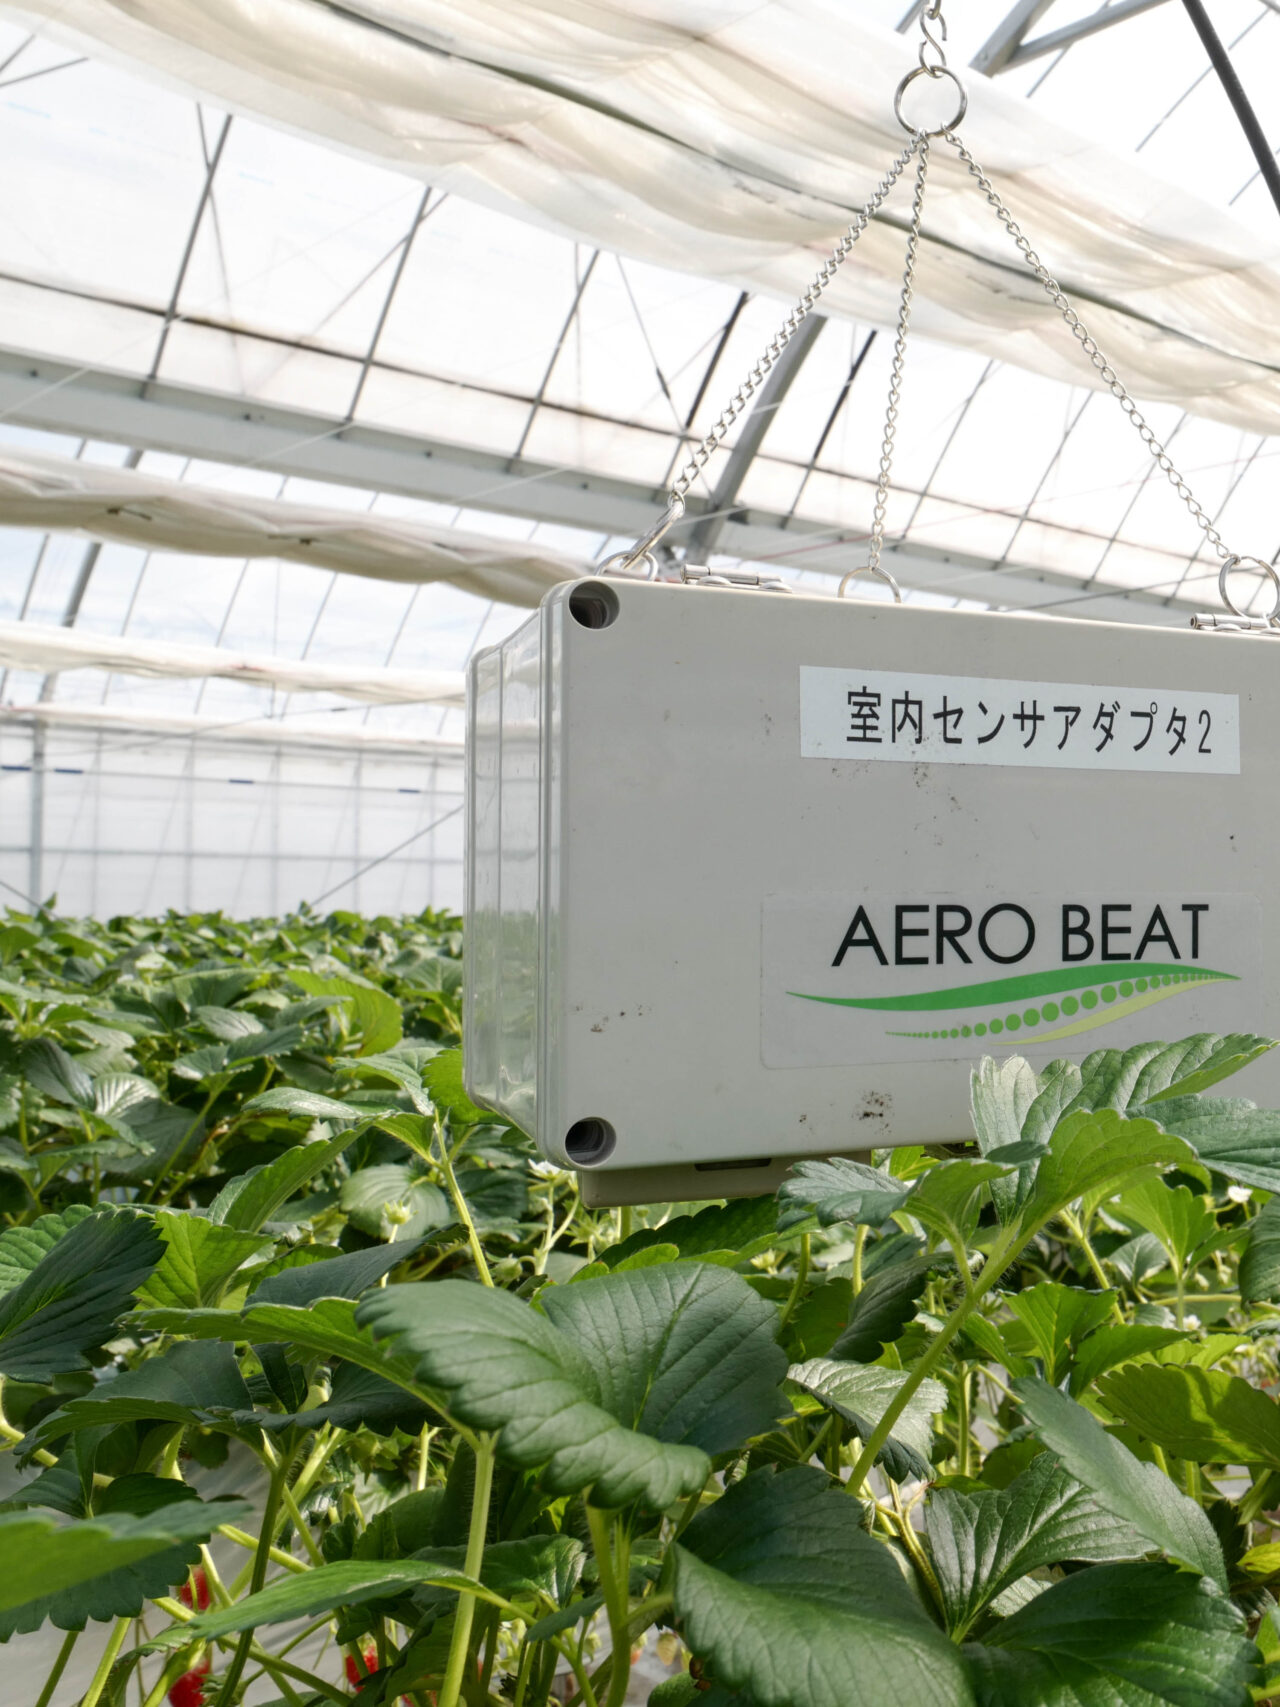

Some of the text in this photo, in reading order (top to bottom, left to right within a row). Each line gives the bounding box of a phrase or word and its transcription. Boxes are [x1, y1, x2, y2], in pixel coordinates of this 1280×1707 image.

[846, 685, 1212, 756] 室内センサアダプタ2
[831, 902, 1209, 967] AERO BEAT
